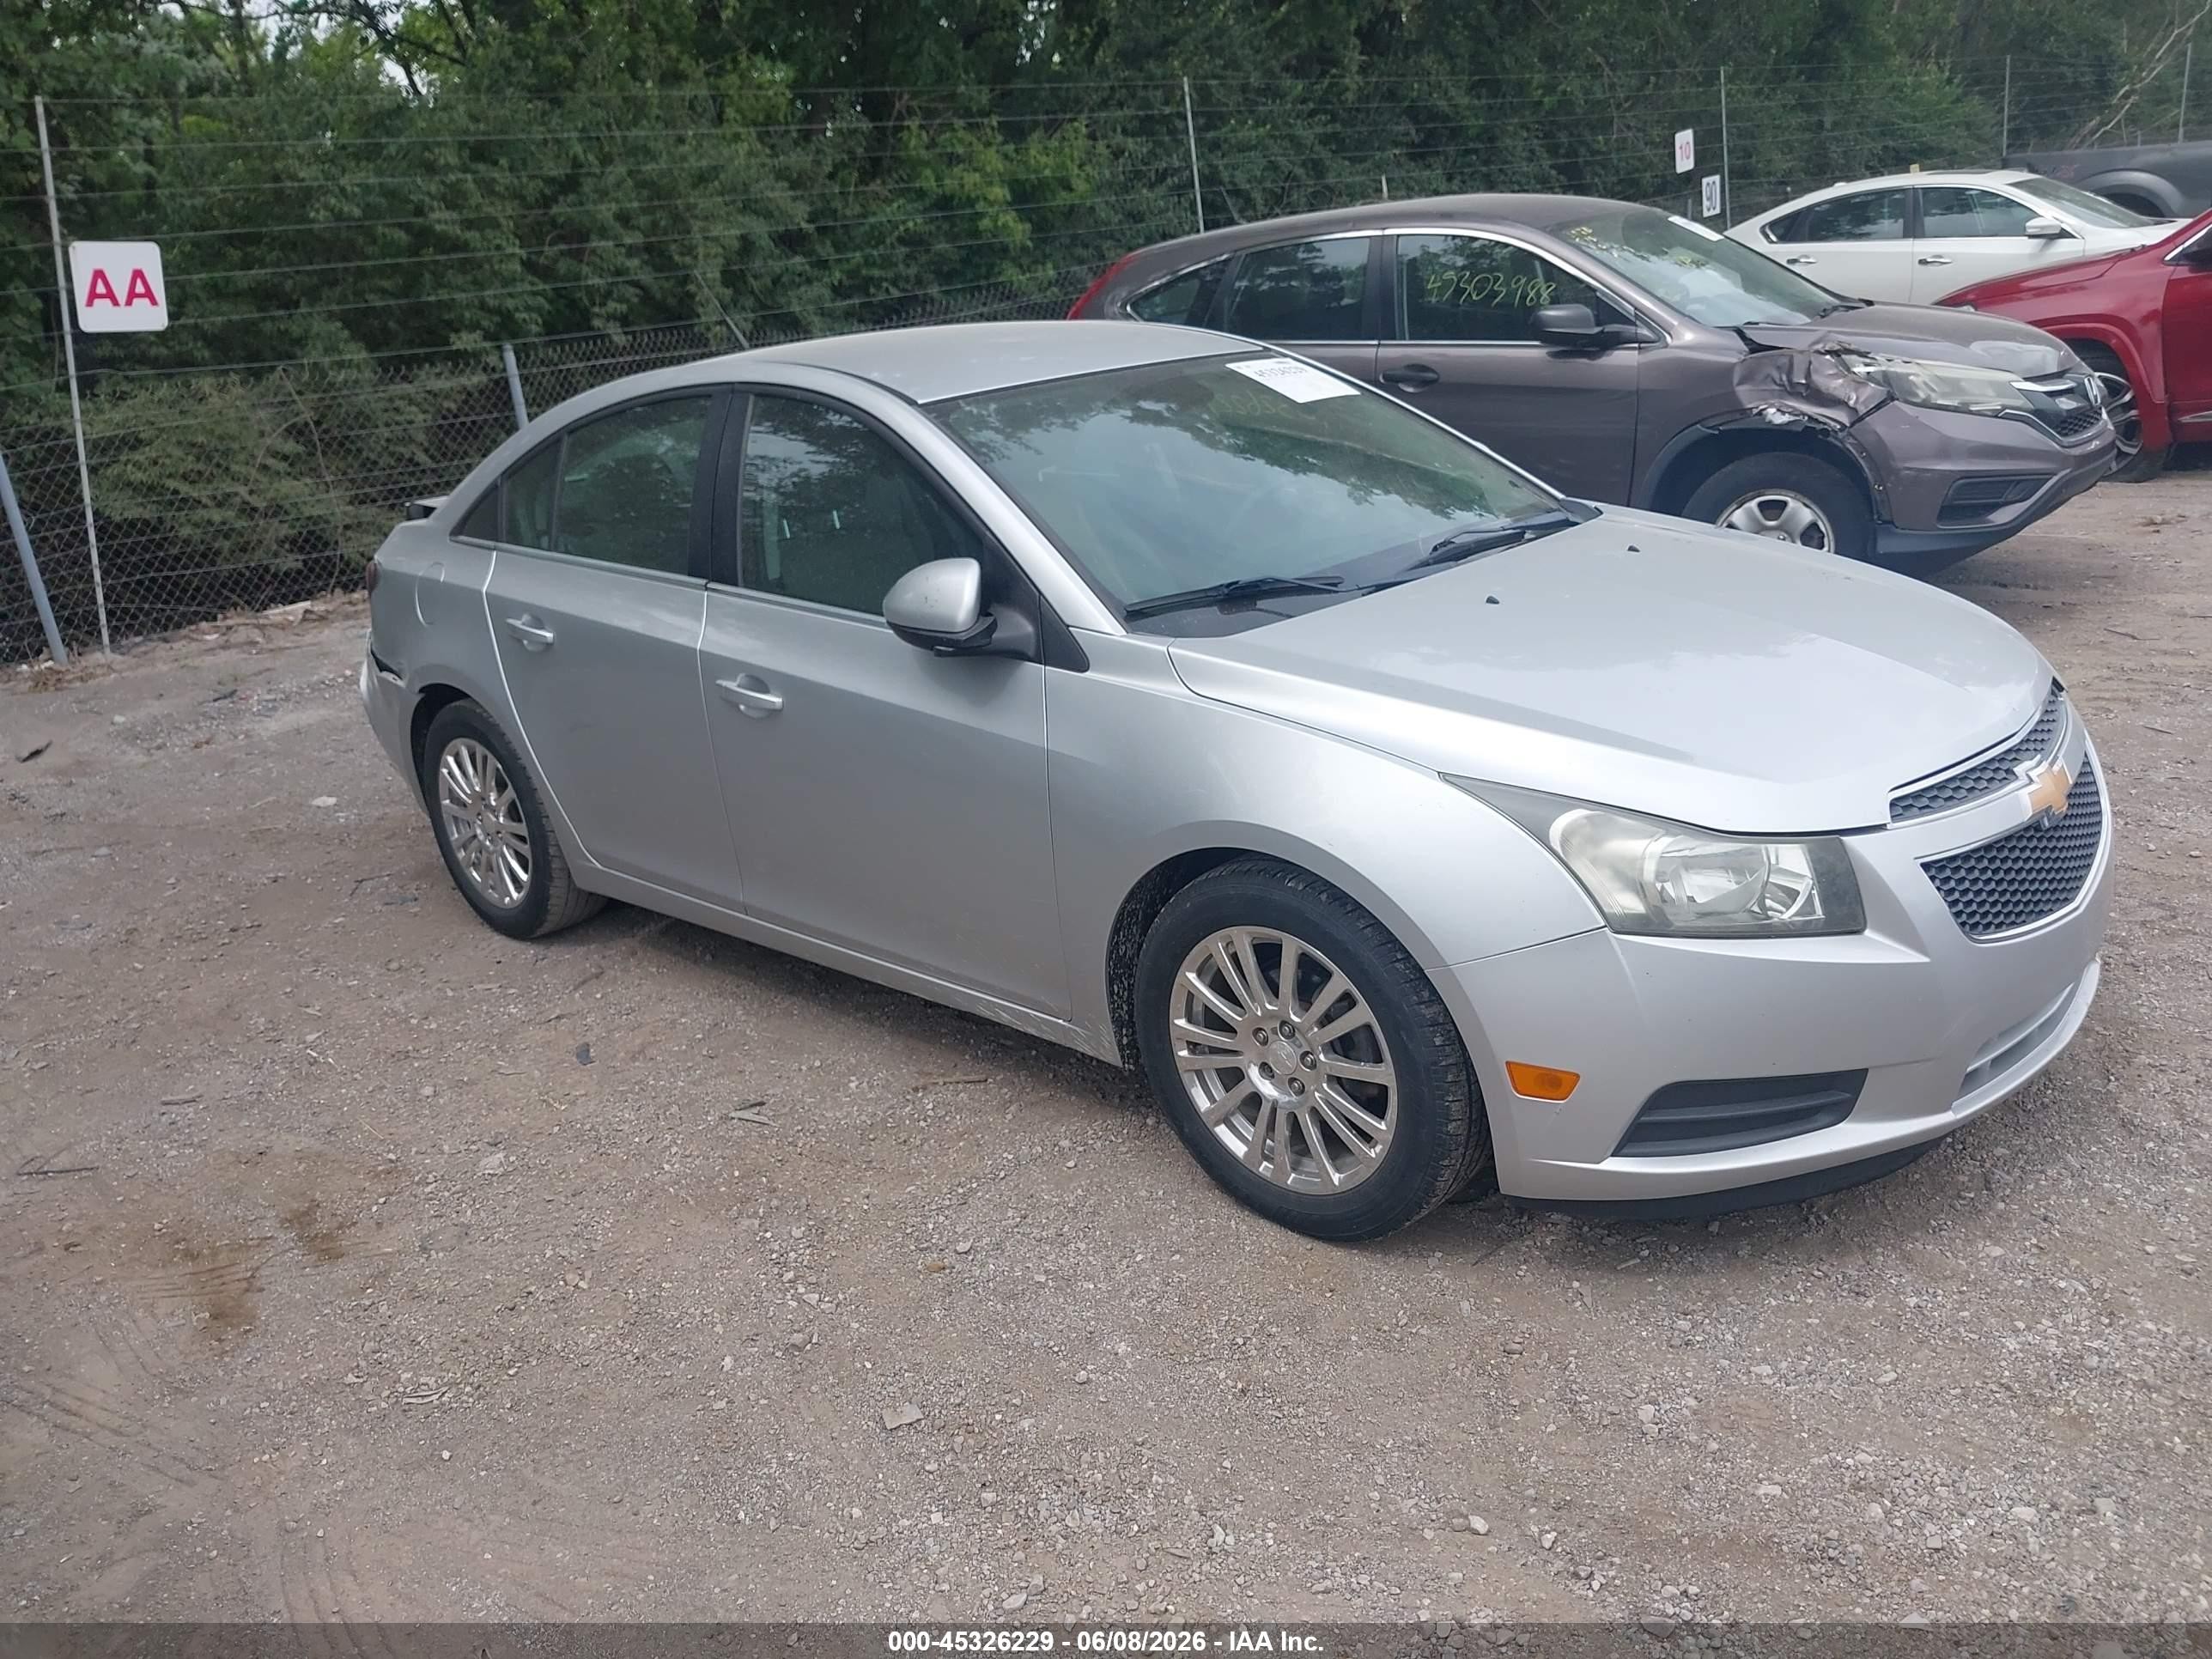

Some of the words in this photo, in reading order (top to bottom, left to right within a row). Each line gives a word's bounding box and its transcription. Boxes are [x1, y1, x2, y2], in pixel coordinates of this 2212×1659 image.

[1679, 142, 1691, 161] 10
[1705, 180, 1717, 212] 90
[85, 268, 160, 307] AA
